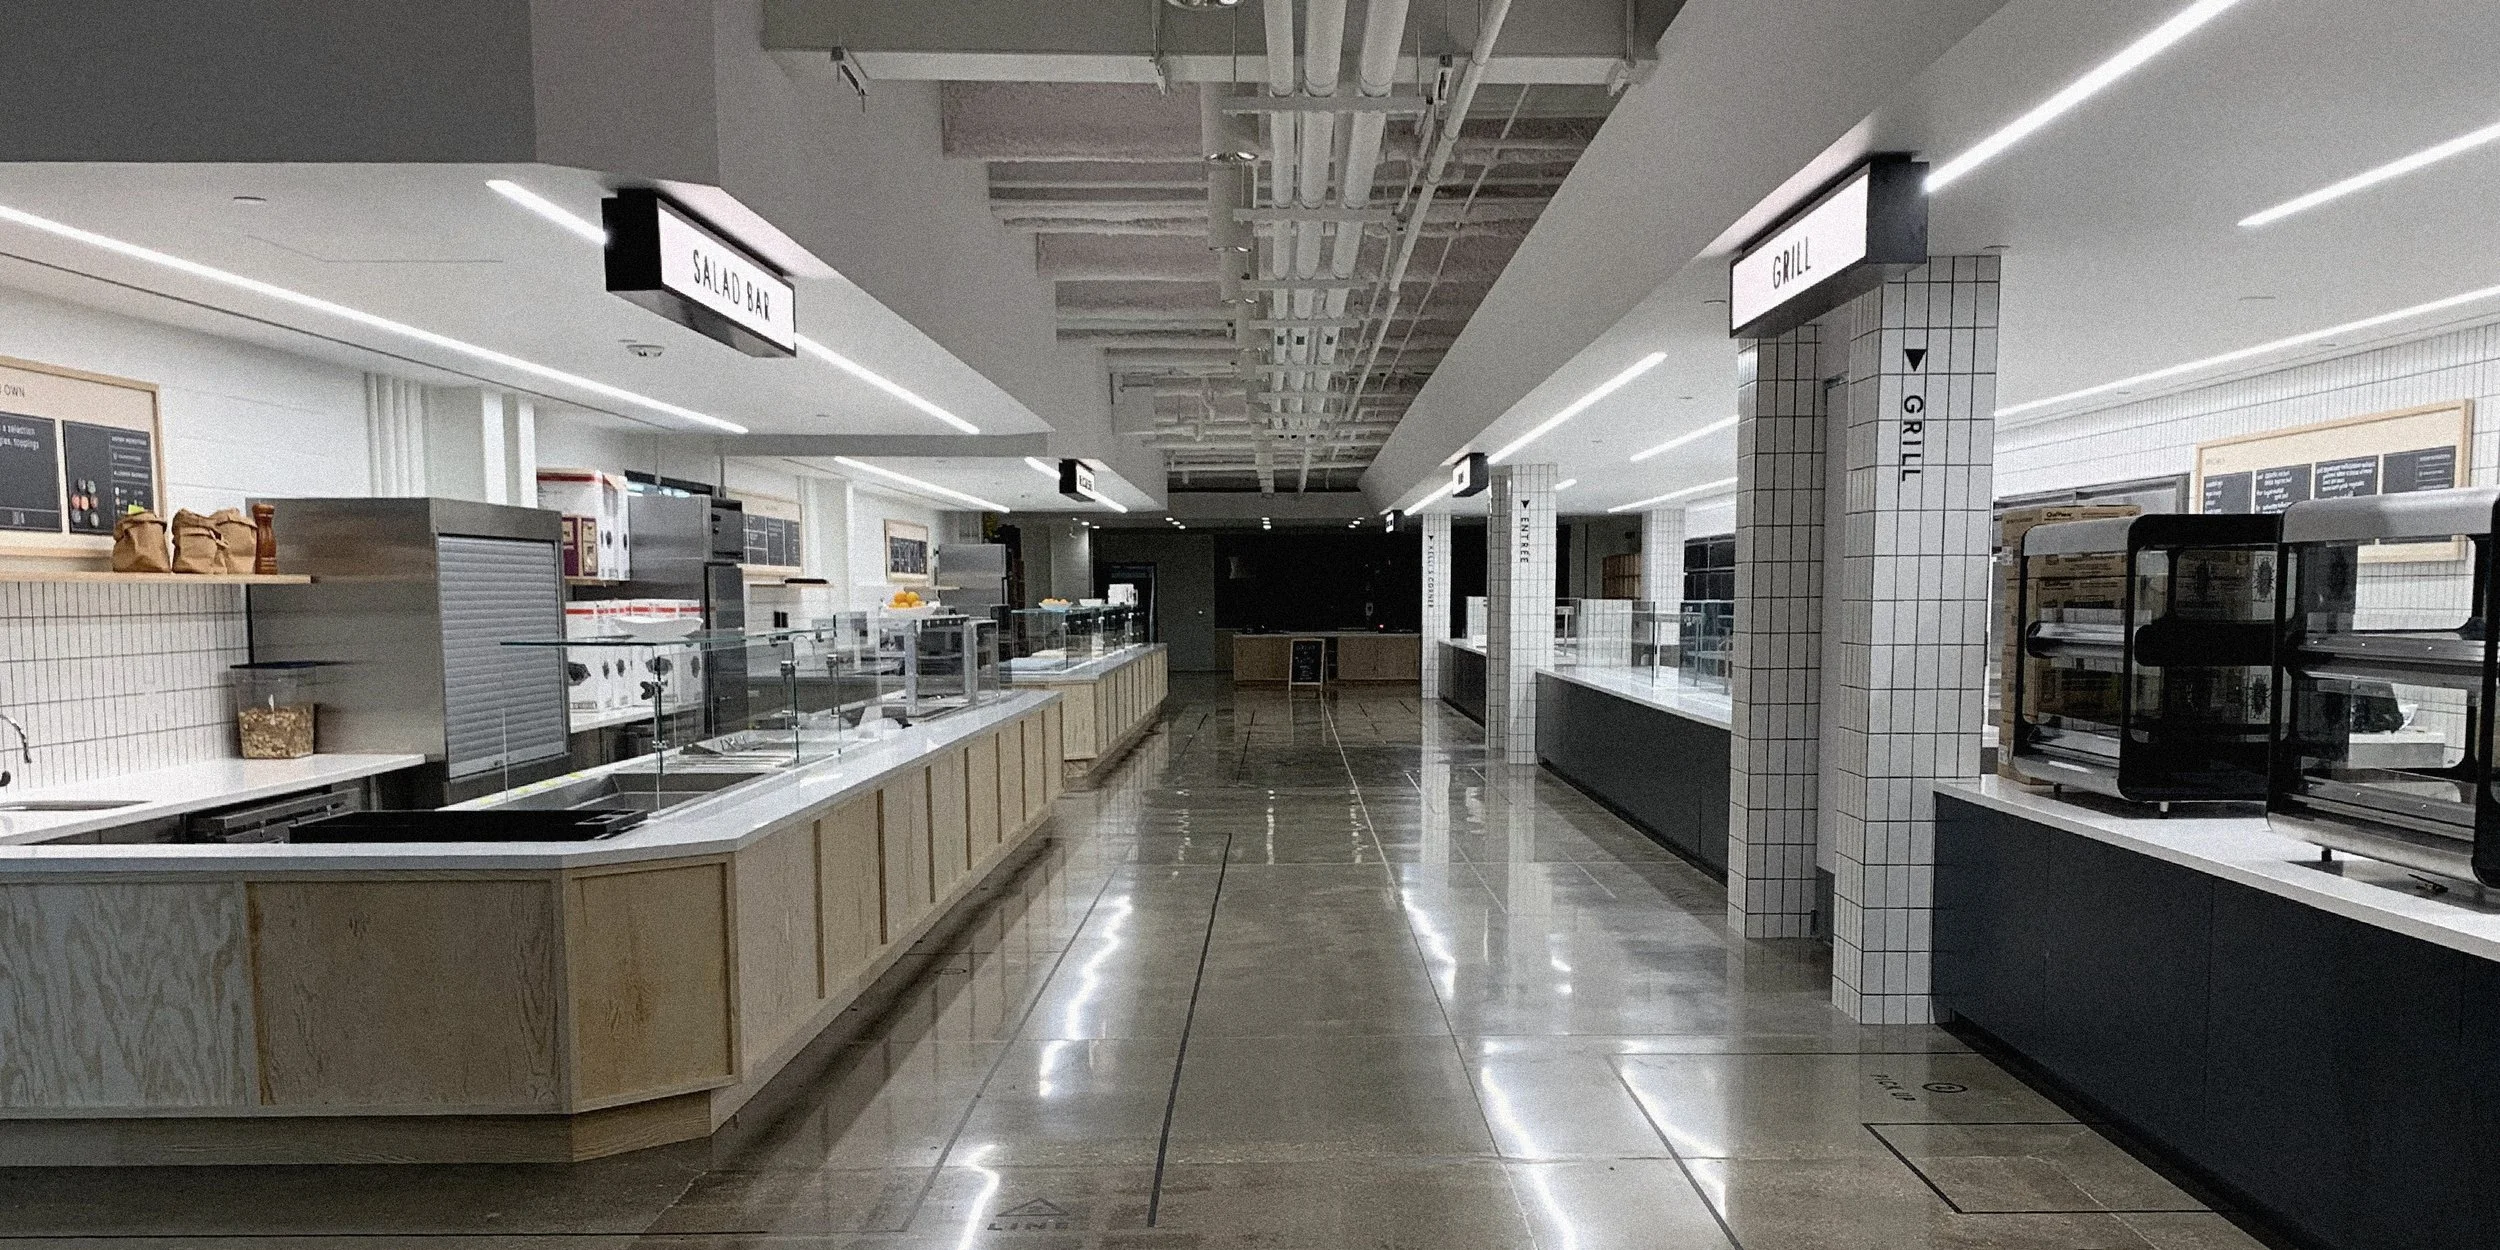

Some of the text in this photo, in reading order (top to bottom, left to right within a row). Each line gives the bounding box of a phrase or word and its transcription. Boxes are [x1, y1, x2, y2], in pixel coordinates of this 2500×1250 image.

[1772, 236, 1812, 289] GRILL
[692, 248, 771, 322] SALAD BAR
[4, 384, 25, 398] OWN
[1902, 395, 1924, 482] GRILL
[1520, 517, 1531, 563] ENTRÉE
[1427, 576, 1435, 608] CORNER
[1869, 1074, 1917, 1102] PICK UP
[986, 1221, 1069, 1232] LINE
